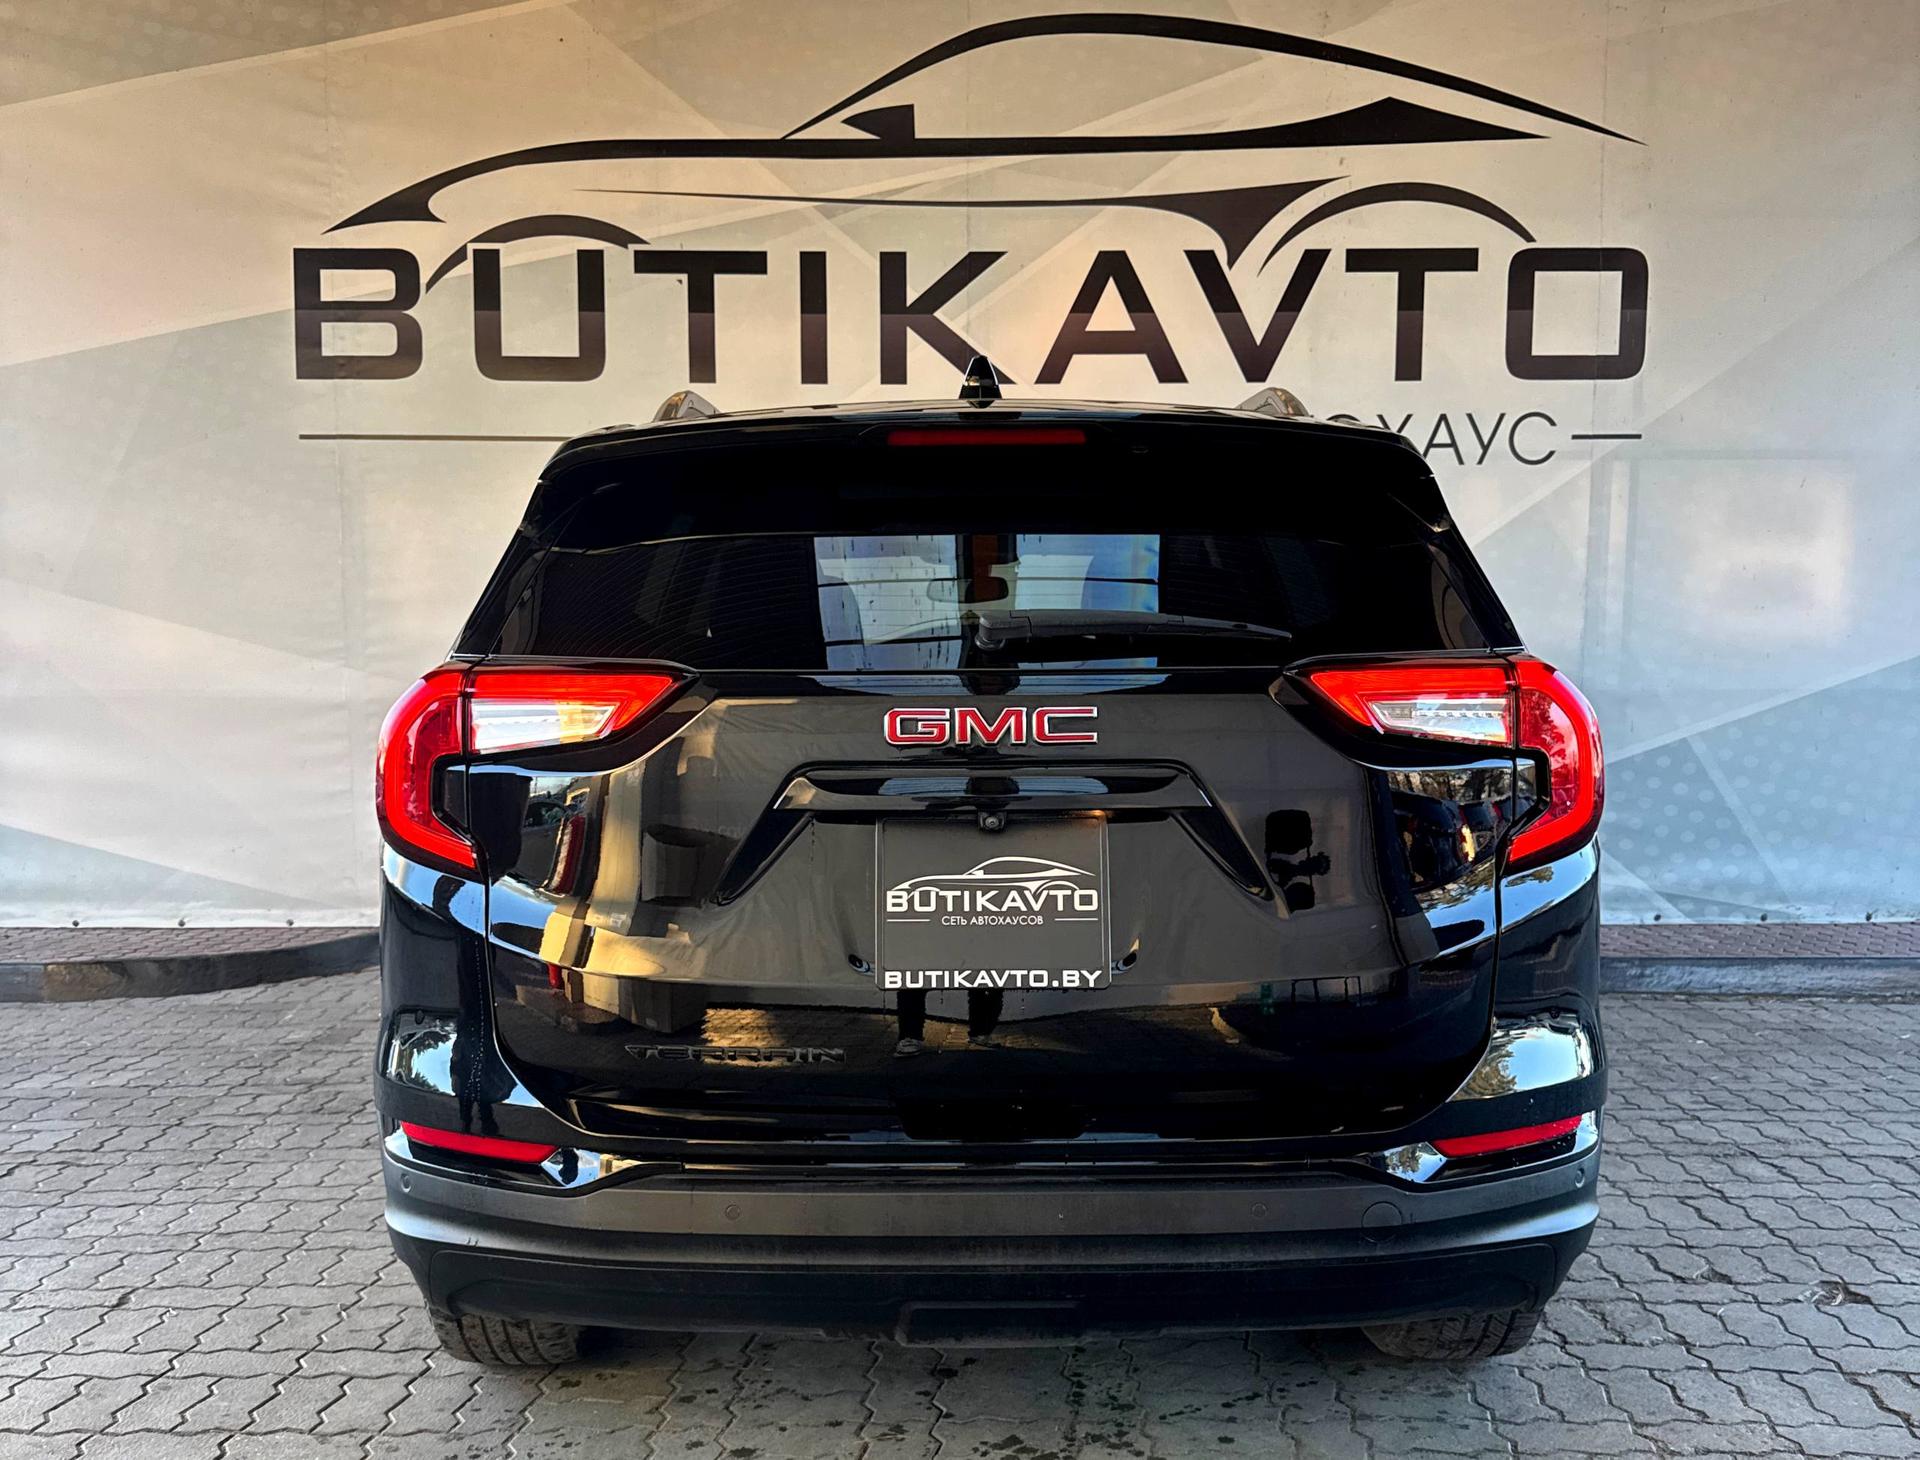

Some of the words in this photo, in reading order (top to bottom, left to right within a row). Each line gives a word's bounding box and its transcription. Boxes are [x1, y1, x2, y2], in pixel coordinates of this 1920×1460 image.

[293, 247, 1648, 385] BUTIKAVTO
[884, 706, 1098, 745] GMC
[886, 889, 1099, 913] BUTIKAVTO
[941, 916, 967, 926] СЕТЬ
[970, 915, 1044, 926] АВТОХАУСОВ
[884, 969, 1102, 988] BUTIKAVTO.BY
[624, 1044, 847, 1065] TERRAIN
